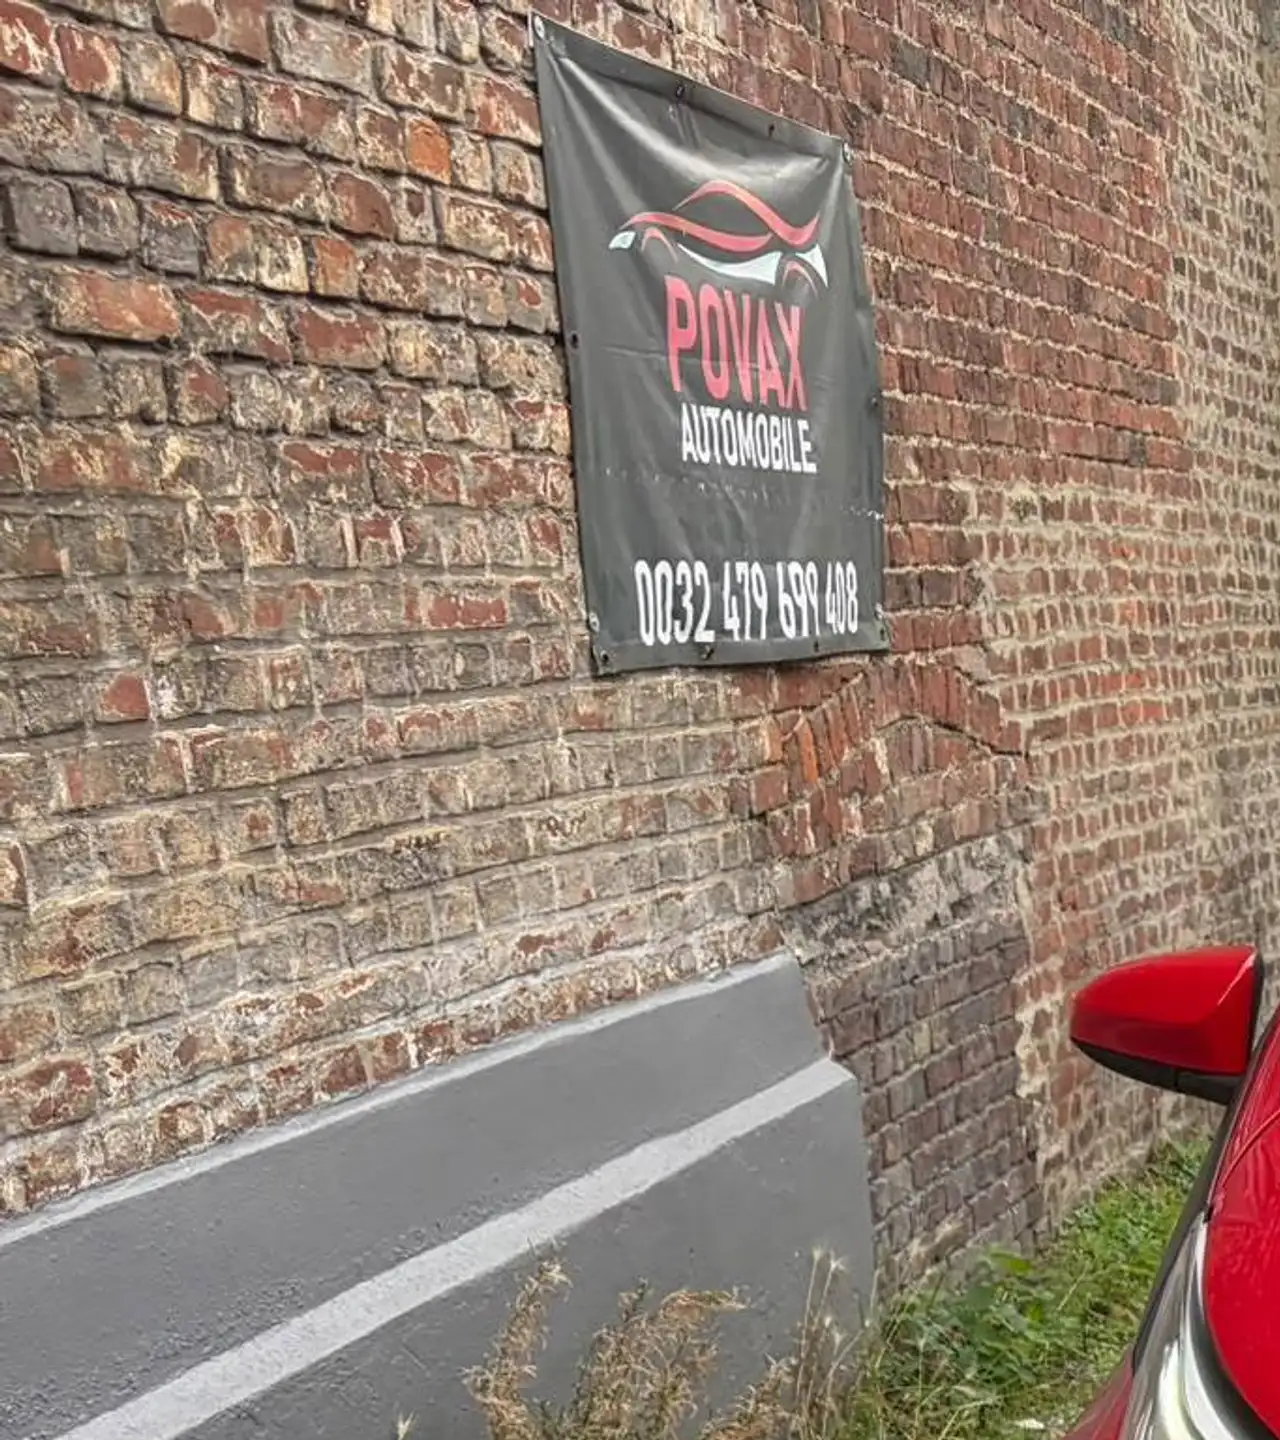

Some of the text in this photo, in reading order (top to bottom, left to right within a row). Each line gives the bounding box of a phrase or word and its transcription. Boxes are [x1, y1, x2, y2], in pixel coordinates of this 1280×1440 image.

[663, 274, 808, 411] POVAX
[681, 402, 818, 474] AUTOMOBILE
[634, 559, 859, 646] 0032 479 699 408
